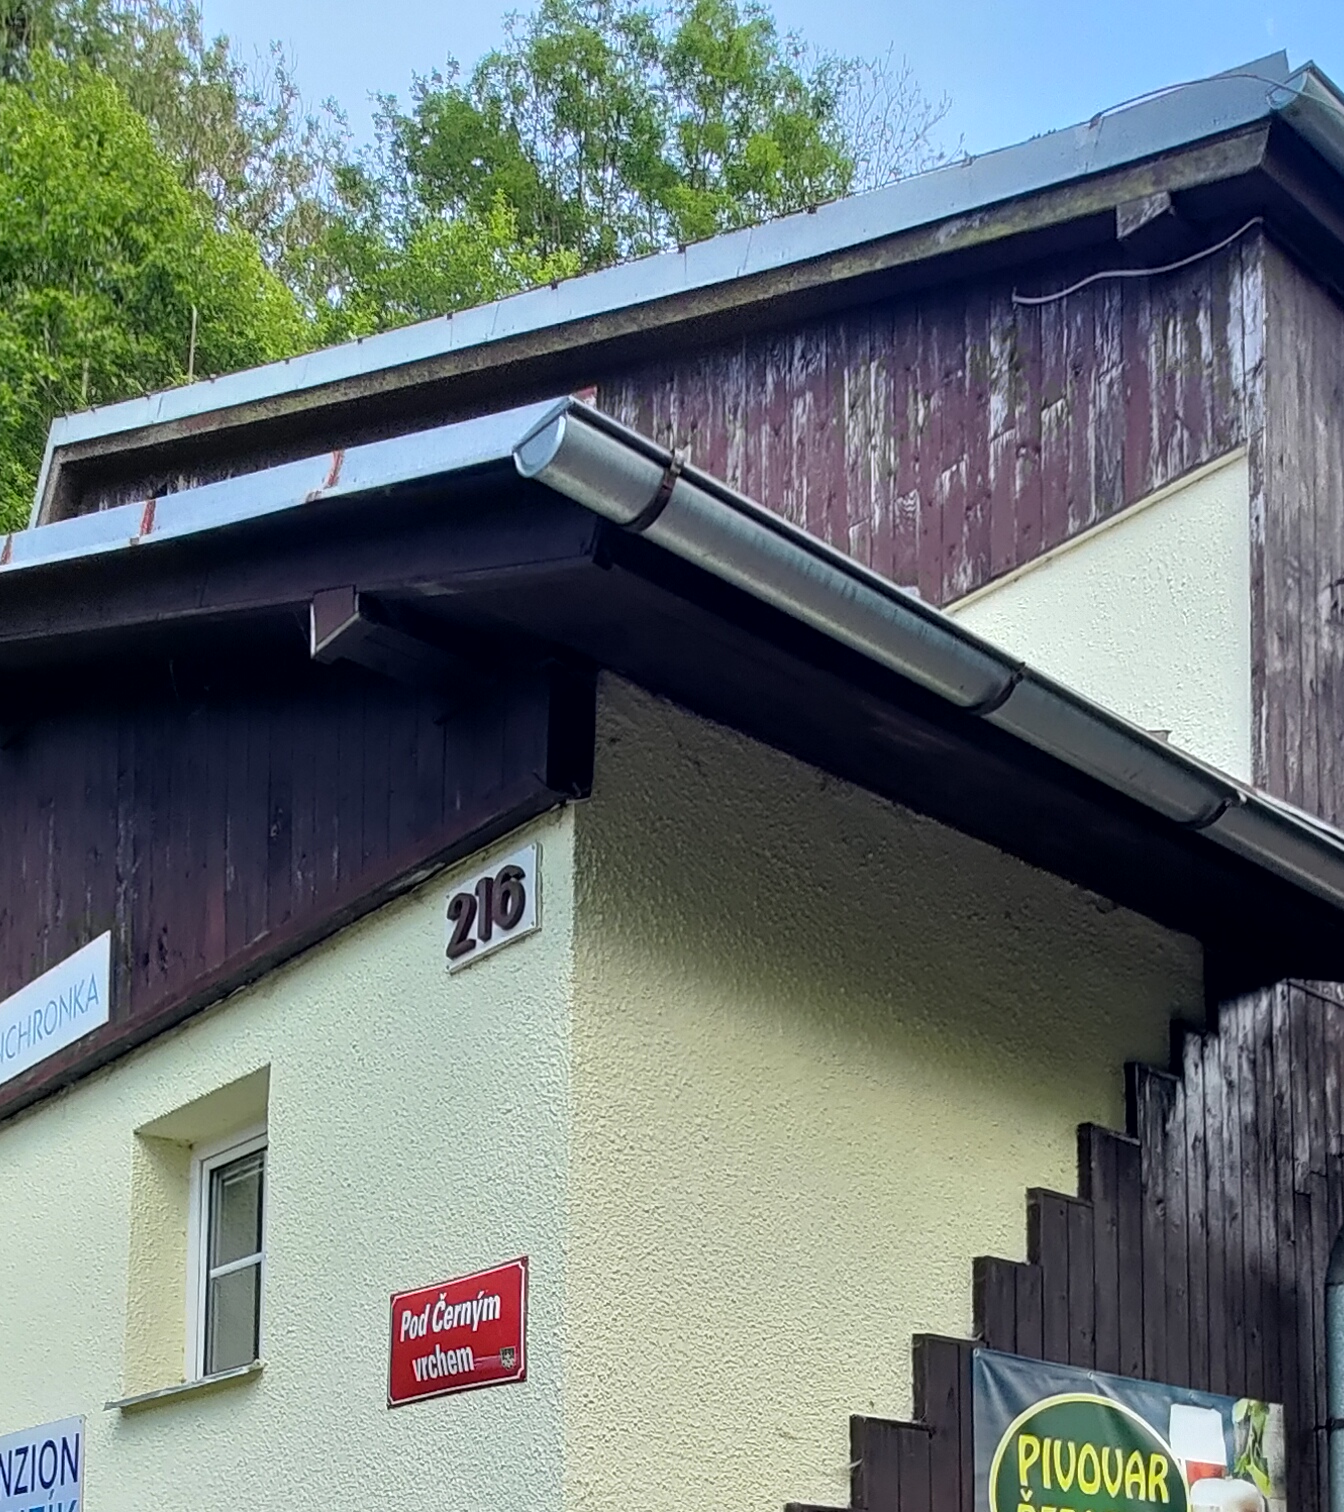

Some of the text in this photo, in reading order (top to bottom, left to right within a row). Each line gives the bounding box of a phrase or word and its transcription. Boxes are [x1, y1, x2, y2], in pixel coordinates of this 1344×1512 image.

[446, 865, 526, 960] 216
[400, 1290, 501, 1342] Pod Černým
[412, 1344, 474, 1382] vrchem
[1018, 1434, 1170, 1503] PIVOVAR
